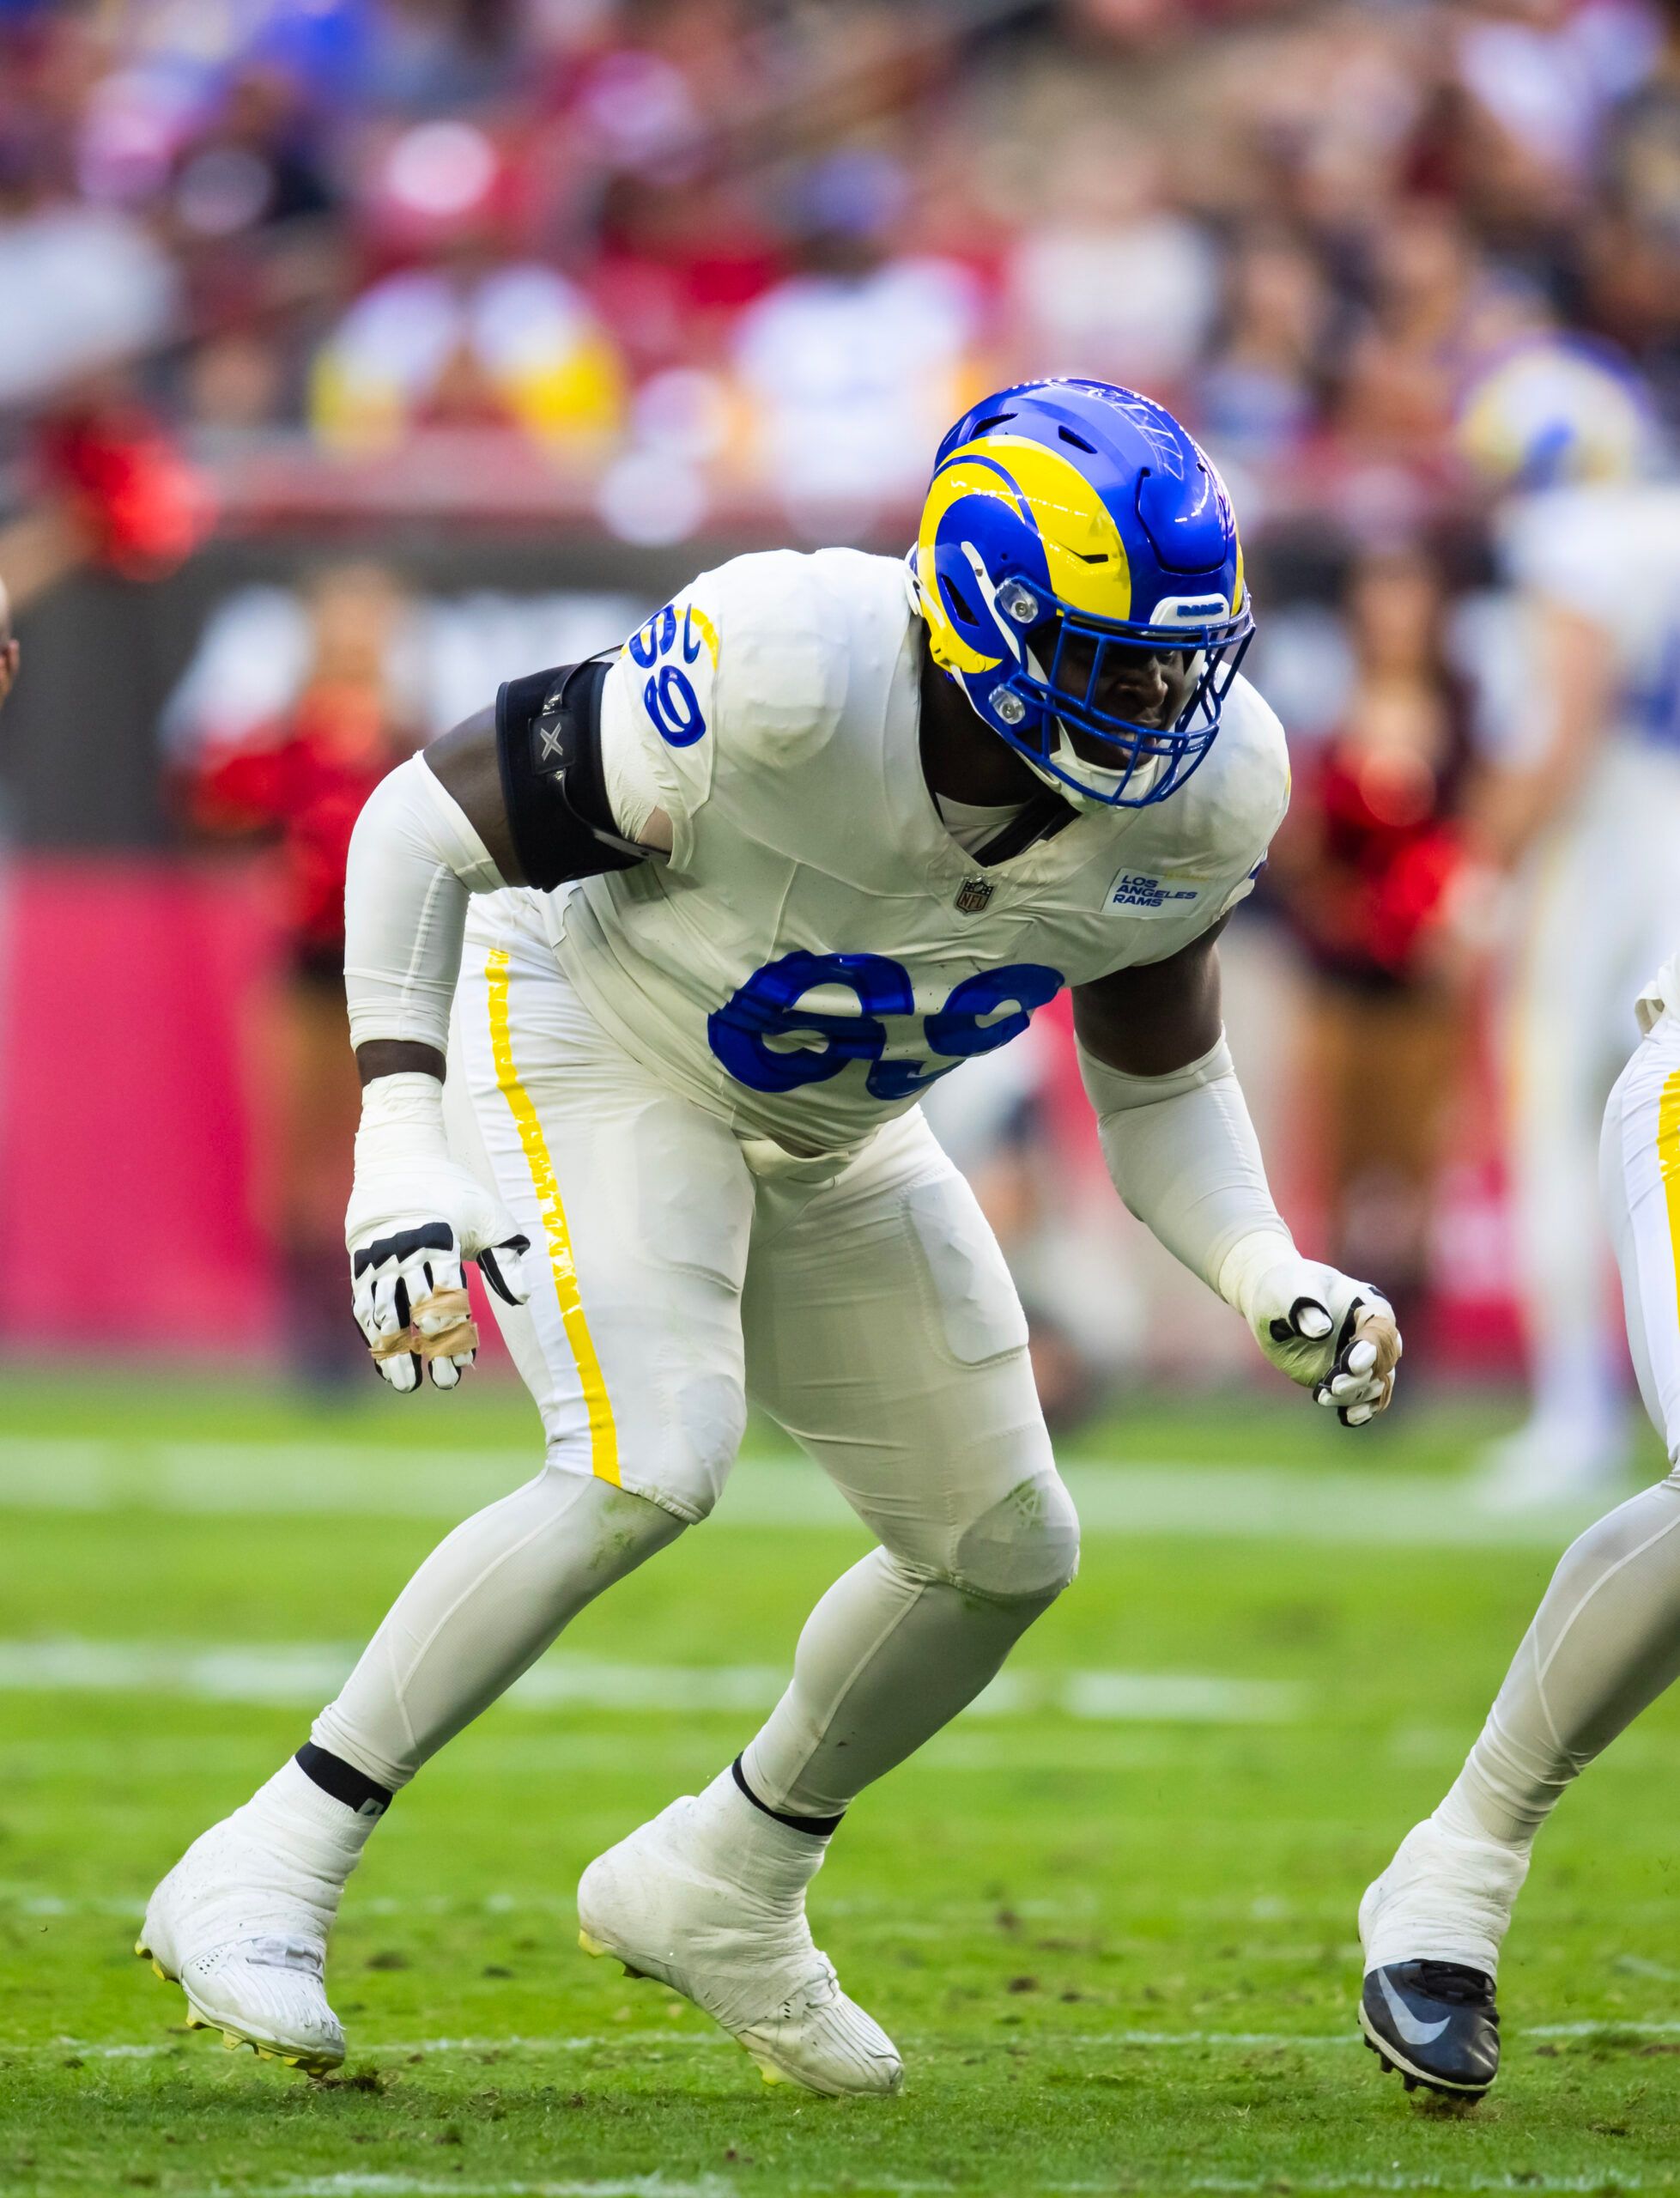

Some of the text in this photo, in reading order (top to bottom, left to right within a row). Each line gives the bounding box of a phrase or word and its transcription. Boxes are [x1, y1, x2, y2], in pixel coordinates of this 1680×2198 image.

[1177, 602, 1224, 617] RAMS
[1121, 875, 1159, 888] LOS
[1116, 884, 1198, 900] ANGELES
[959, 893, 986, 909] NFL
[1113, 894, 1163, 908] RAMS
[707, 950, 1065, 1101] 69
